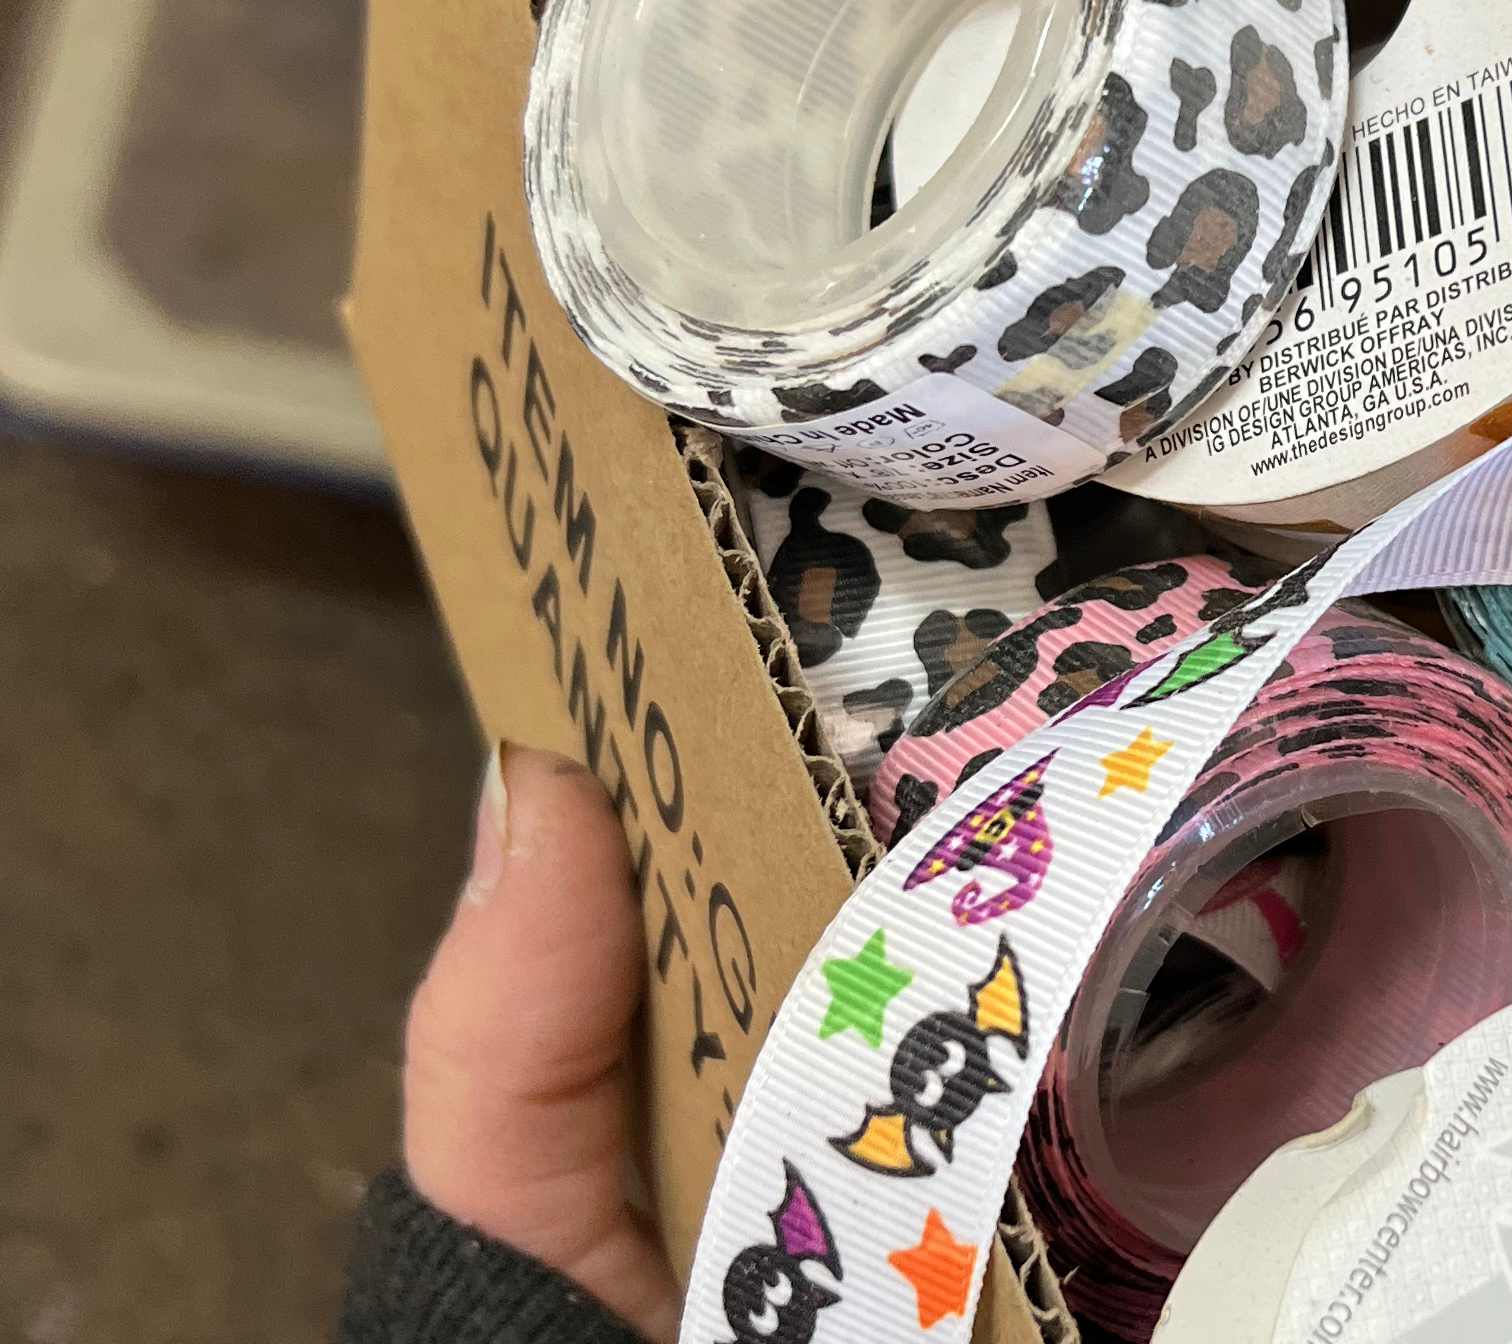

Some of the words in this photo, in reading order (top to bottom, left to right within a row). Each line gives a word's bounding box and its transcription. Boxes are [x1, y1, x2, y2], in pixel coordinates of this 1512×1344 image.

[1352, 97, 1426, 142] HECHO
[1432, 80, 1461, 107] EN
[1228, 360, 1255, 387] BY
[1260, 312, 1370, 374] DISTRIBUÉ
[1375, 298, 1421, 329] PAR
[1259, 342, 1357, 395] BERWICK
[1360, 307, 1444, 355] OFFRAY
[480, 209, 597, 598] ITEM
[799, 430, 841, 441] In
[834, 403, 927, 436] Made
[1145, 445, 1158, 464] A
[1160, 410, 1235, 457] DIVISION
[1238, 385, 1302, 423] OF/UNE
[1306, 347, 1387, 398] DIVISION
[1391, 325, 1461, 367] DE/UNA
[1206, 439, 1226, 457] IG
[1229, 409, 1296, 448] DESIGN
[1299, 381, 1364, 419] GROUP
[1368, 342, 1473, 395] AMERICAS,
[1250, 380, 1472, 477] www.thedesigngroup.com
[1271, 405, 1360, 451] ATLANTA,
[1362, 391, 1391, 413] GA
[1394, 370, 1449, 401] U.S.A.
[919, 442, 1000, 473] Size:
[1004, 464, 1056, 486] Item
